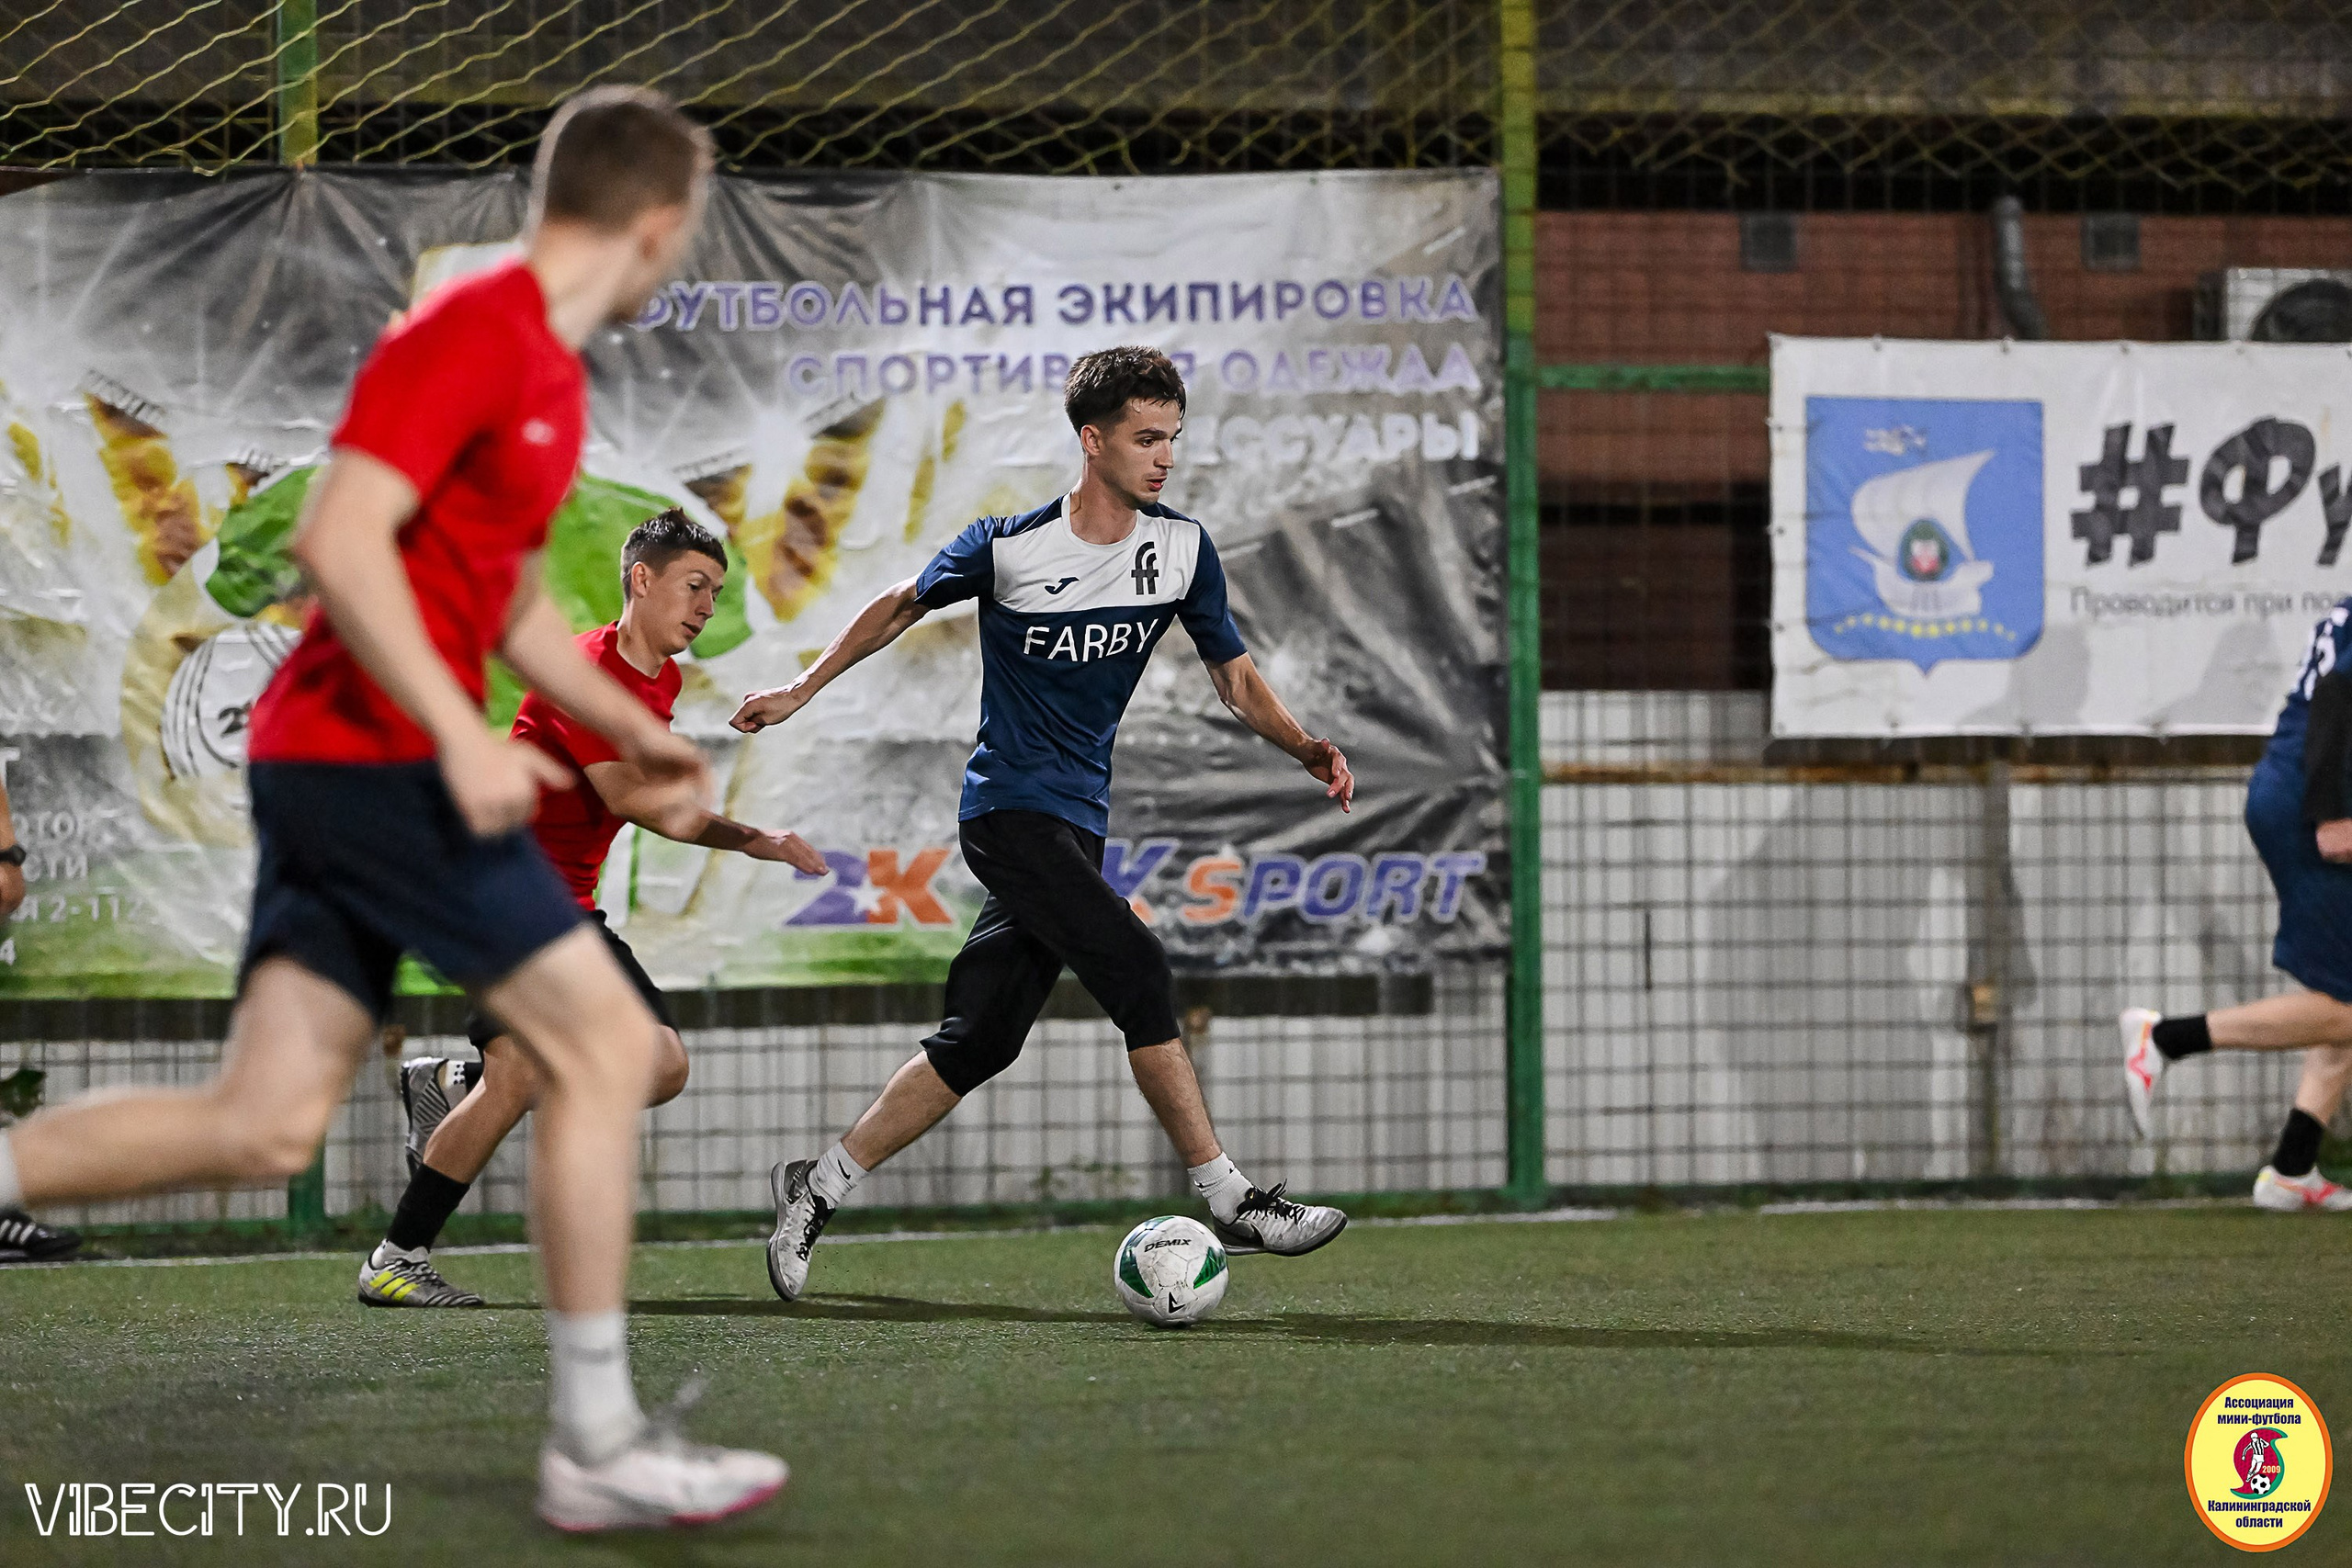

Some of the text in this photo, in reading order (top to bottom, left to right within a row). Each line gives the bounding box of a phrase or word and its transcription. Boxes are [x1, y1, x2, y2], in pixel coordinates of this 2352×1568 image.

[1056, 278, 1476, 326] ЭКИПИРОВКА
[787, 351, 1195, 396] СПОРТИВЯ
[1185, 410, 1480, 461] ЕССУАРЫ
[1023, 617, 1159, 663] FARBY
[1180, 847, 1487, 926] SPORT
[1143, 1238, 1193, 1253] DEMIX
